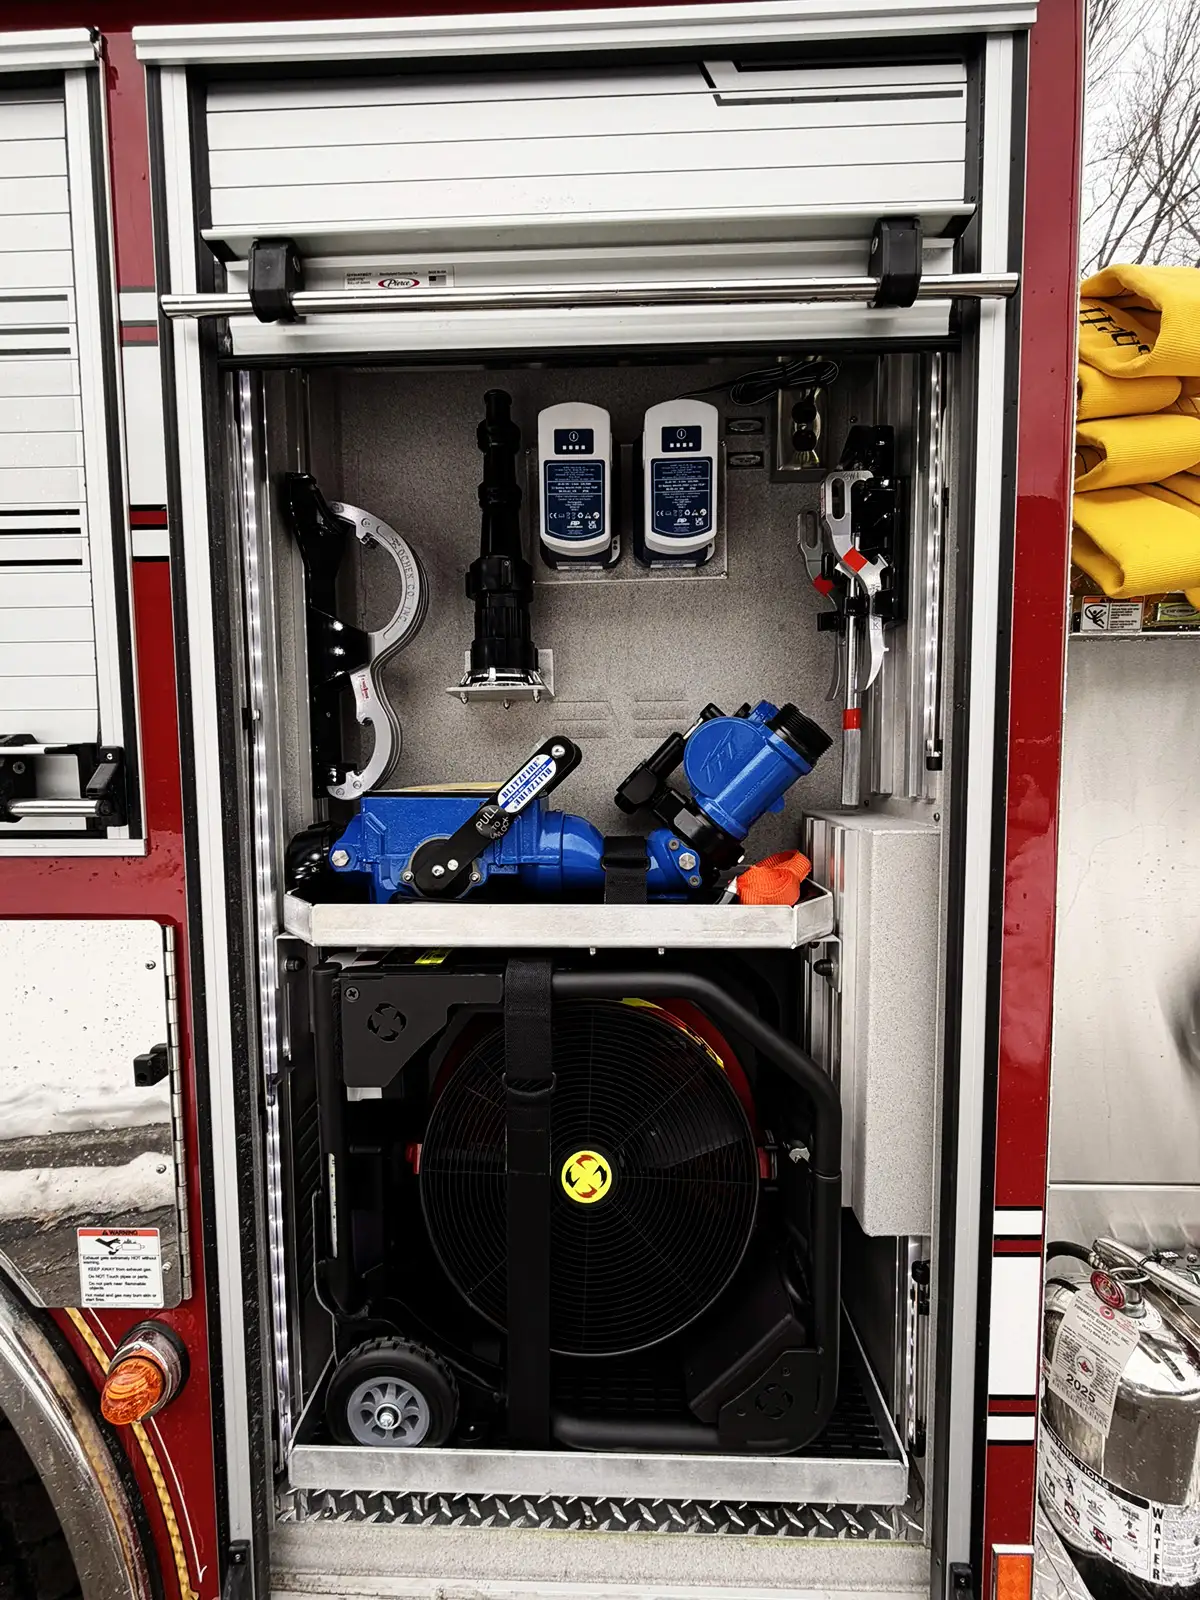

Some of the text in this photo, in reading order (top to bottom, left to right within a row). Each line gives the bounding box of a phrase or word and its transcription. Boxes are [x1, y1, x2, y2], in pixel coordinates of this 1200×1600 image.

[388, 278, 410, 287] Pierce
[476, 807, 498, 830] PULL
[491, 821, 501, 831] TO
[1066, 1373, 1096, 1403] 2025
[1152, 1506, 1164, 1580] WATER
